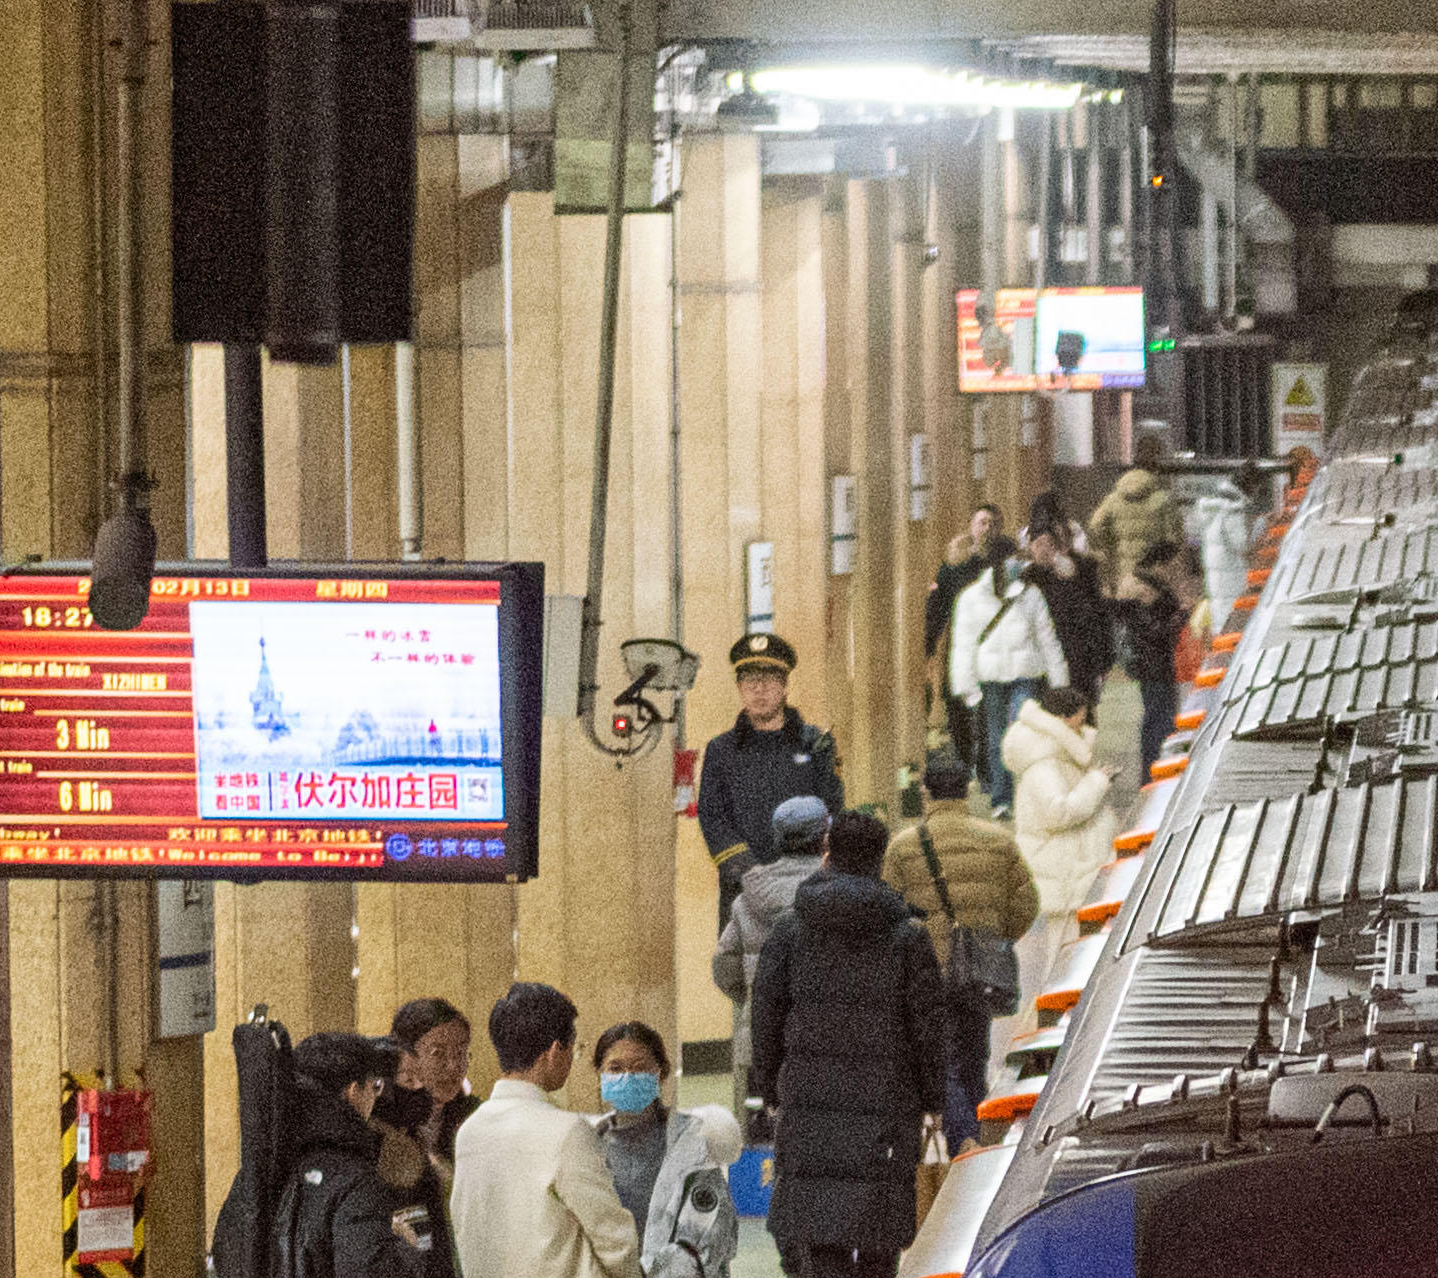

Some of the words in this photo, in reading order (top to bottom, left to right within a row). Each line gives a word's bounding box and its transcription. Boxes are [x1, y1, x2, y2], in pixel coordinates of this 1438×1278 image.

[56, 719, 70, 749] 3
[59, 781, 73, 812] 6
[294, 772, 458, 811] 伏尔加庄园
